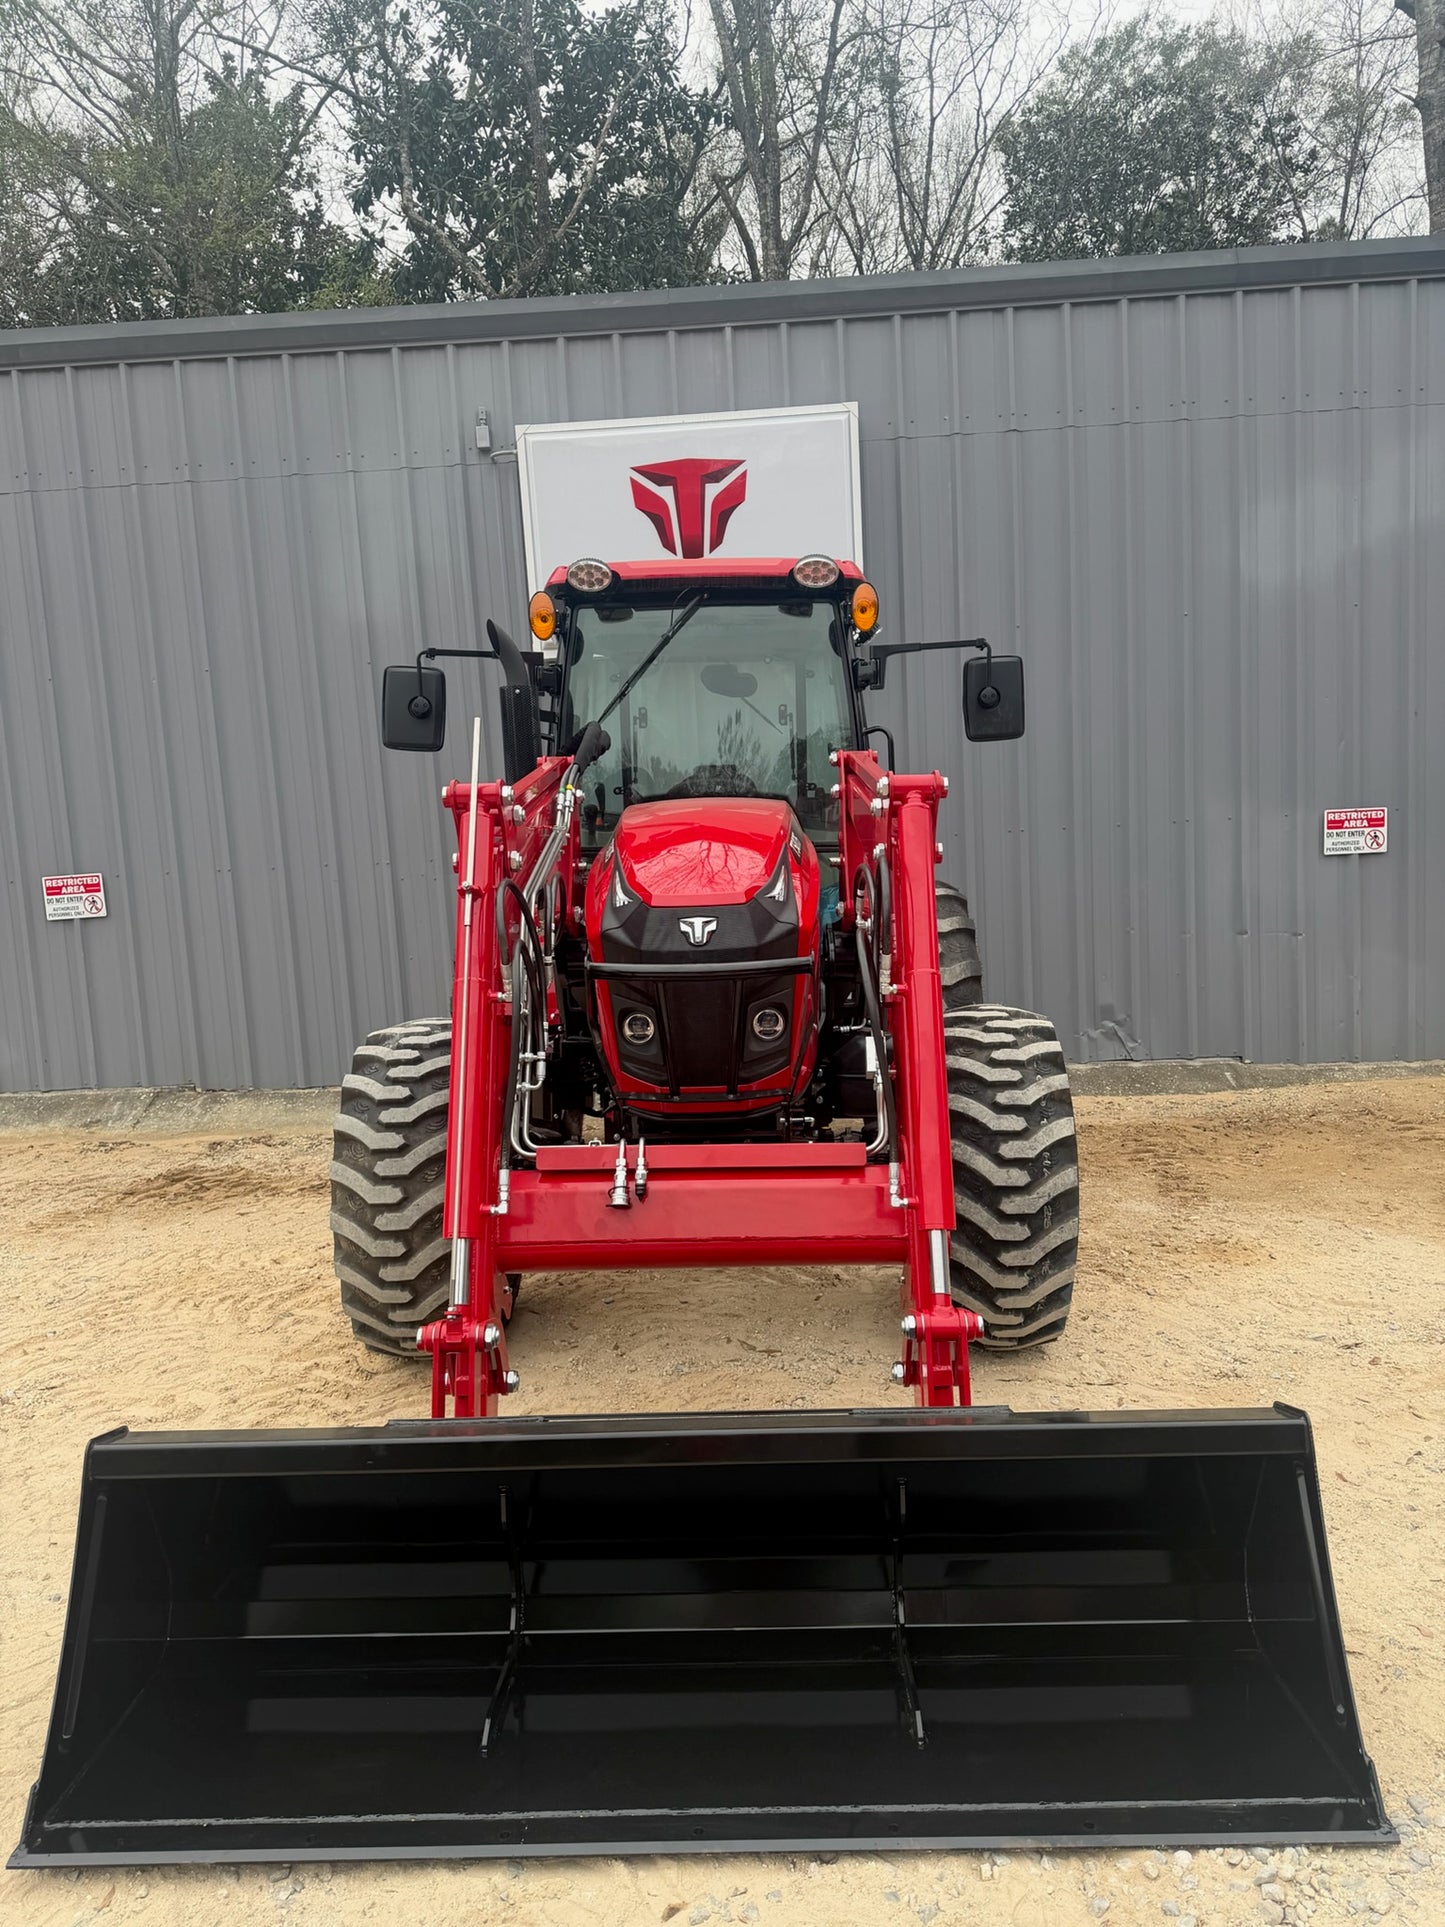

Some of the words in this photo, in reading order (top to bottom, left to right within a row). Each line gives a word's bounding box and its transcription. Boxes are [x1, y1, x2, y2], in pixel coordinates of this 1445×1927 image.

[1328, 811, 1384, 820] RESTRICTED
[1343, 820, 1368, 828] AREA
[46, 877, 99, 887] RESTRICTED
[61, 886, 85, 894] AREA
